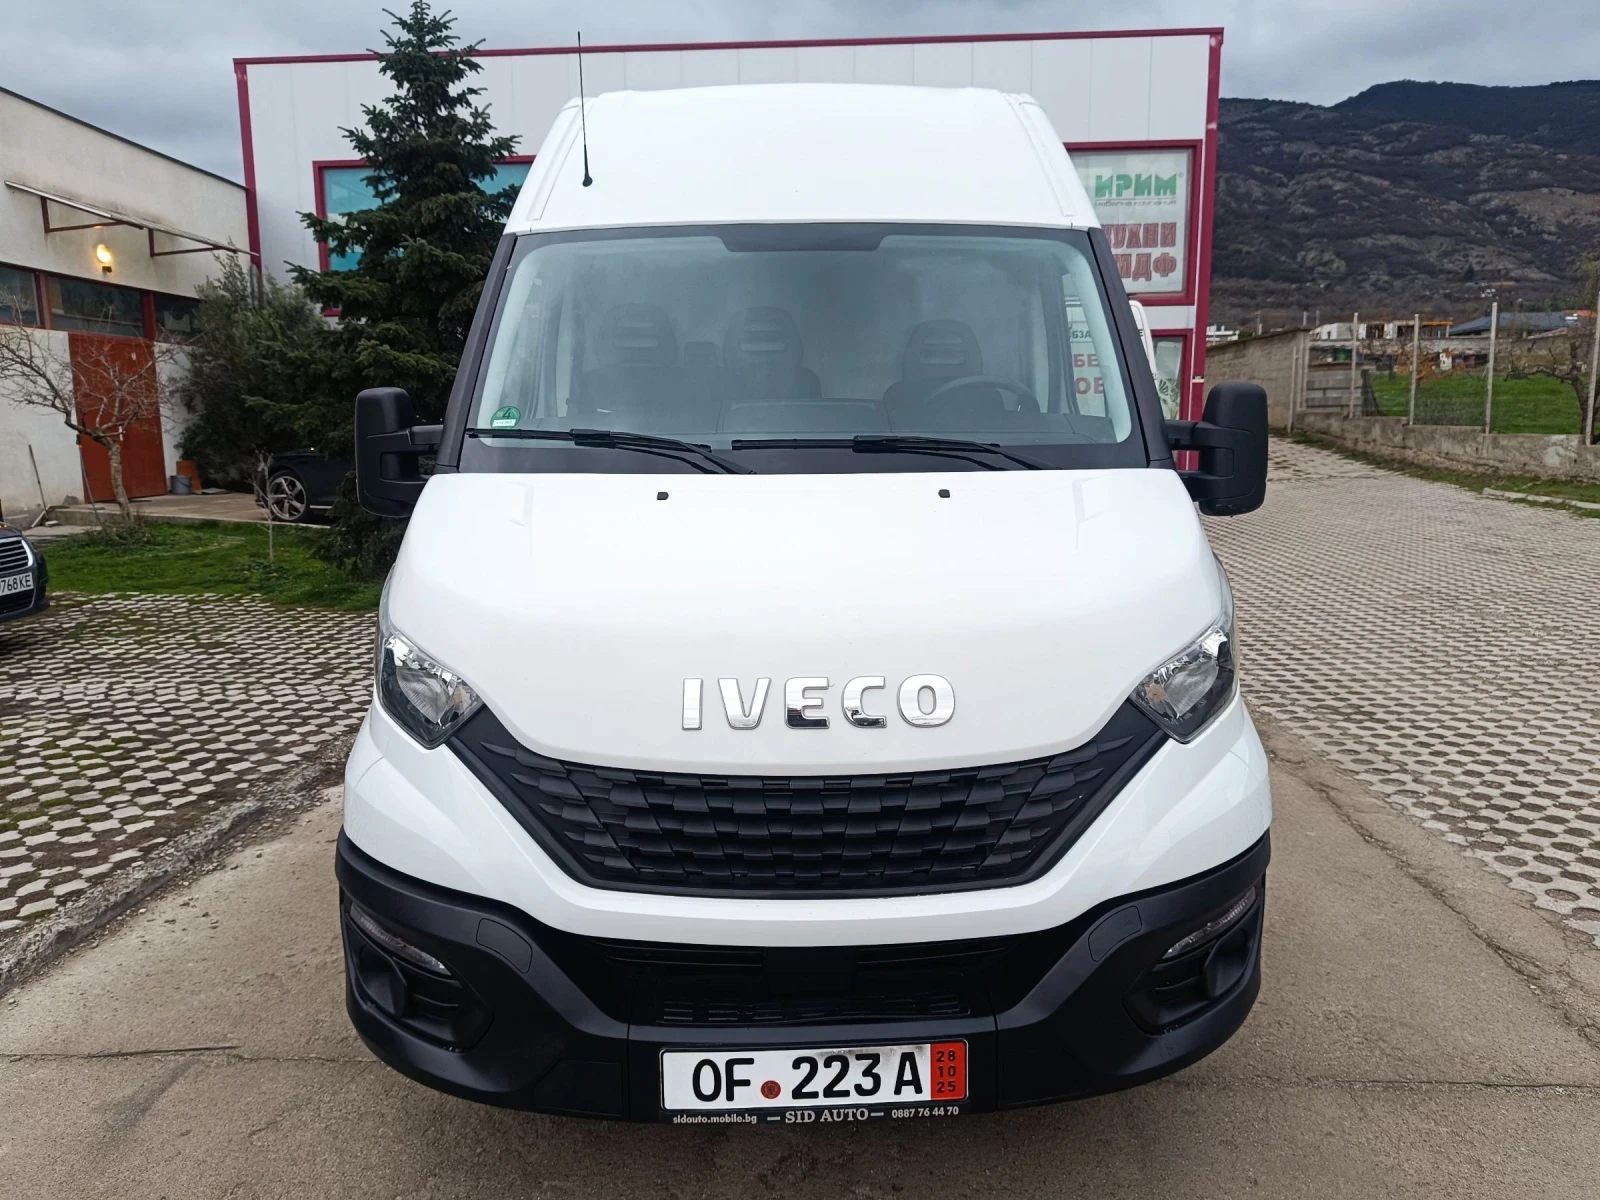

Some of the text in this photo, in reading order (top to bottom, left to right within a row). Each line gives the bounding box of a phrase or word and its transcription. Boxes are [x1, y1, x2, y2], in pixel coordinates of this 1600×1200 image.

[1095, 173, 1177, 198] ИРИМ
[681, 674, 956, 730] IVECO
[936, 1050, 956, 1062] 28
[692, 1052, 923, 1102] OF 223 A
[938, 1065, 956, 1078] 10
[936, 1081, 956, 1093] 25
[673, 1106, 959, 1124] sidauto.mobile.bg SID AUTO 0887 76 44 70
